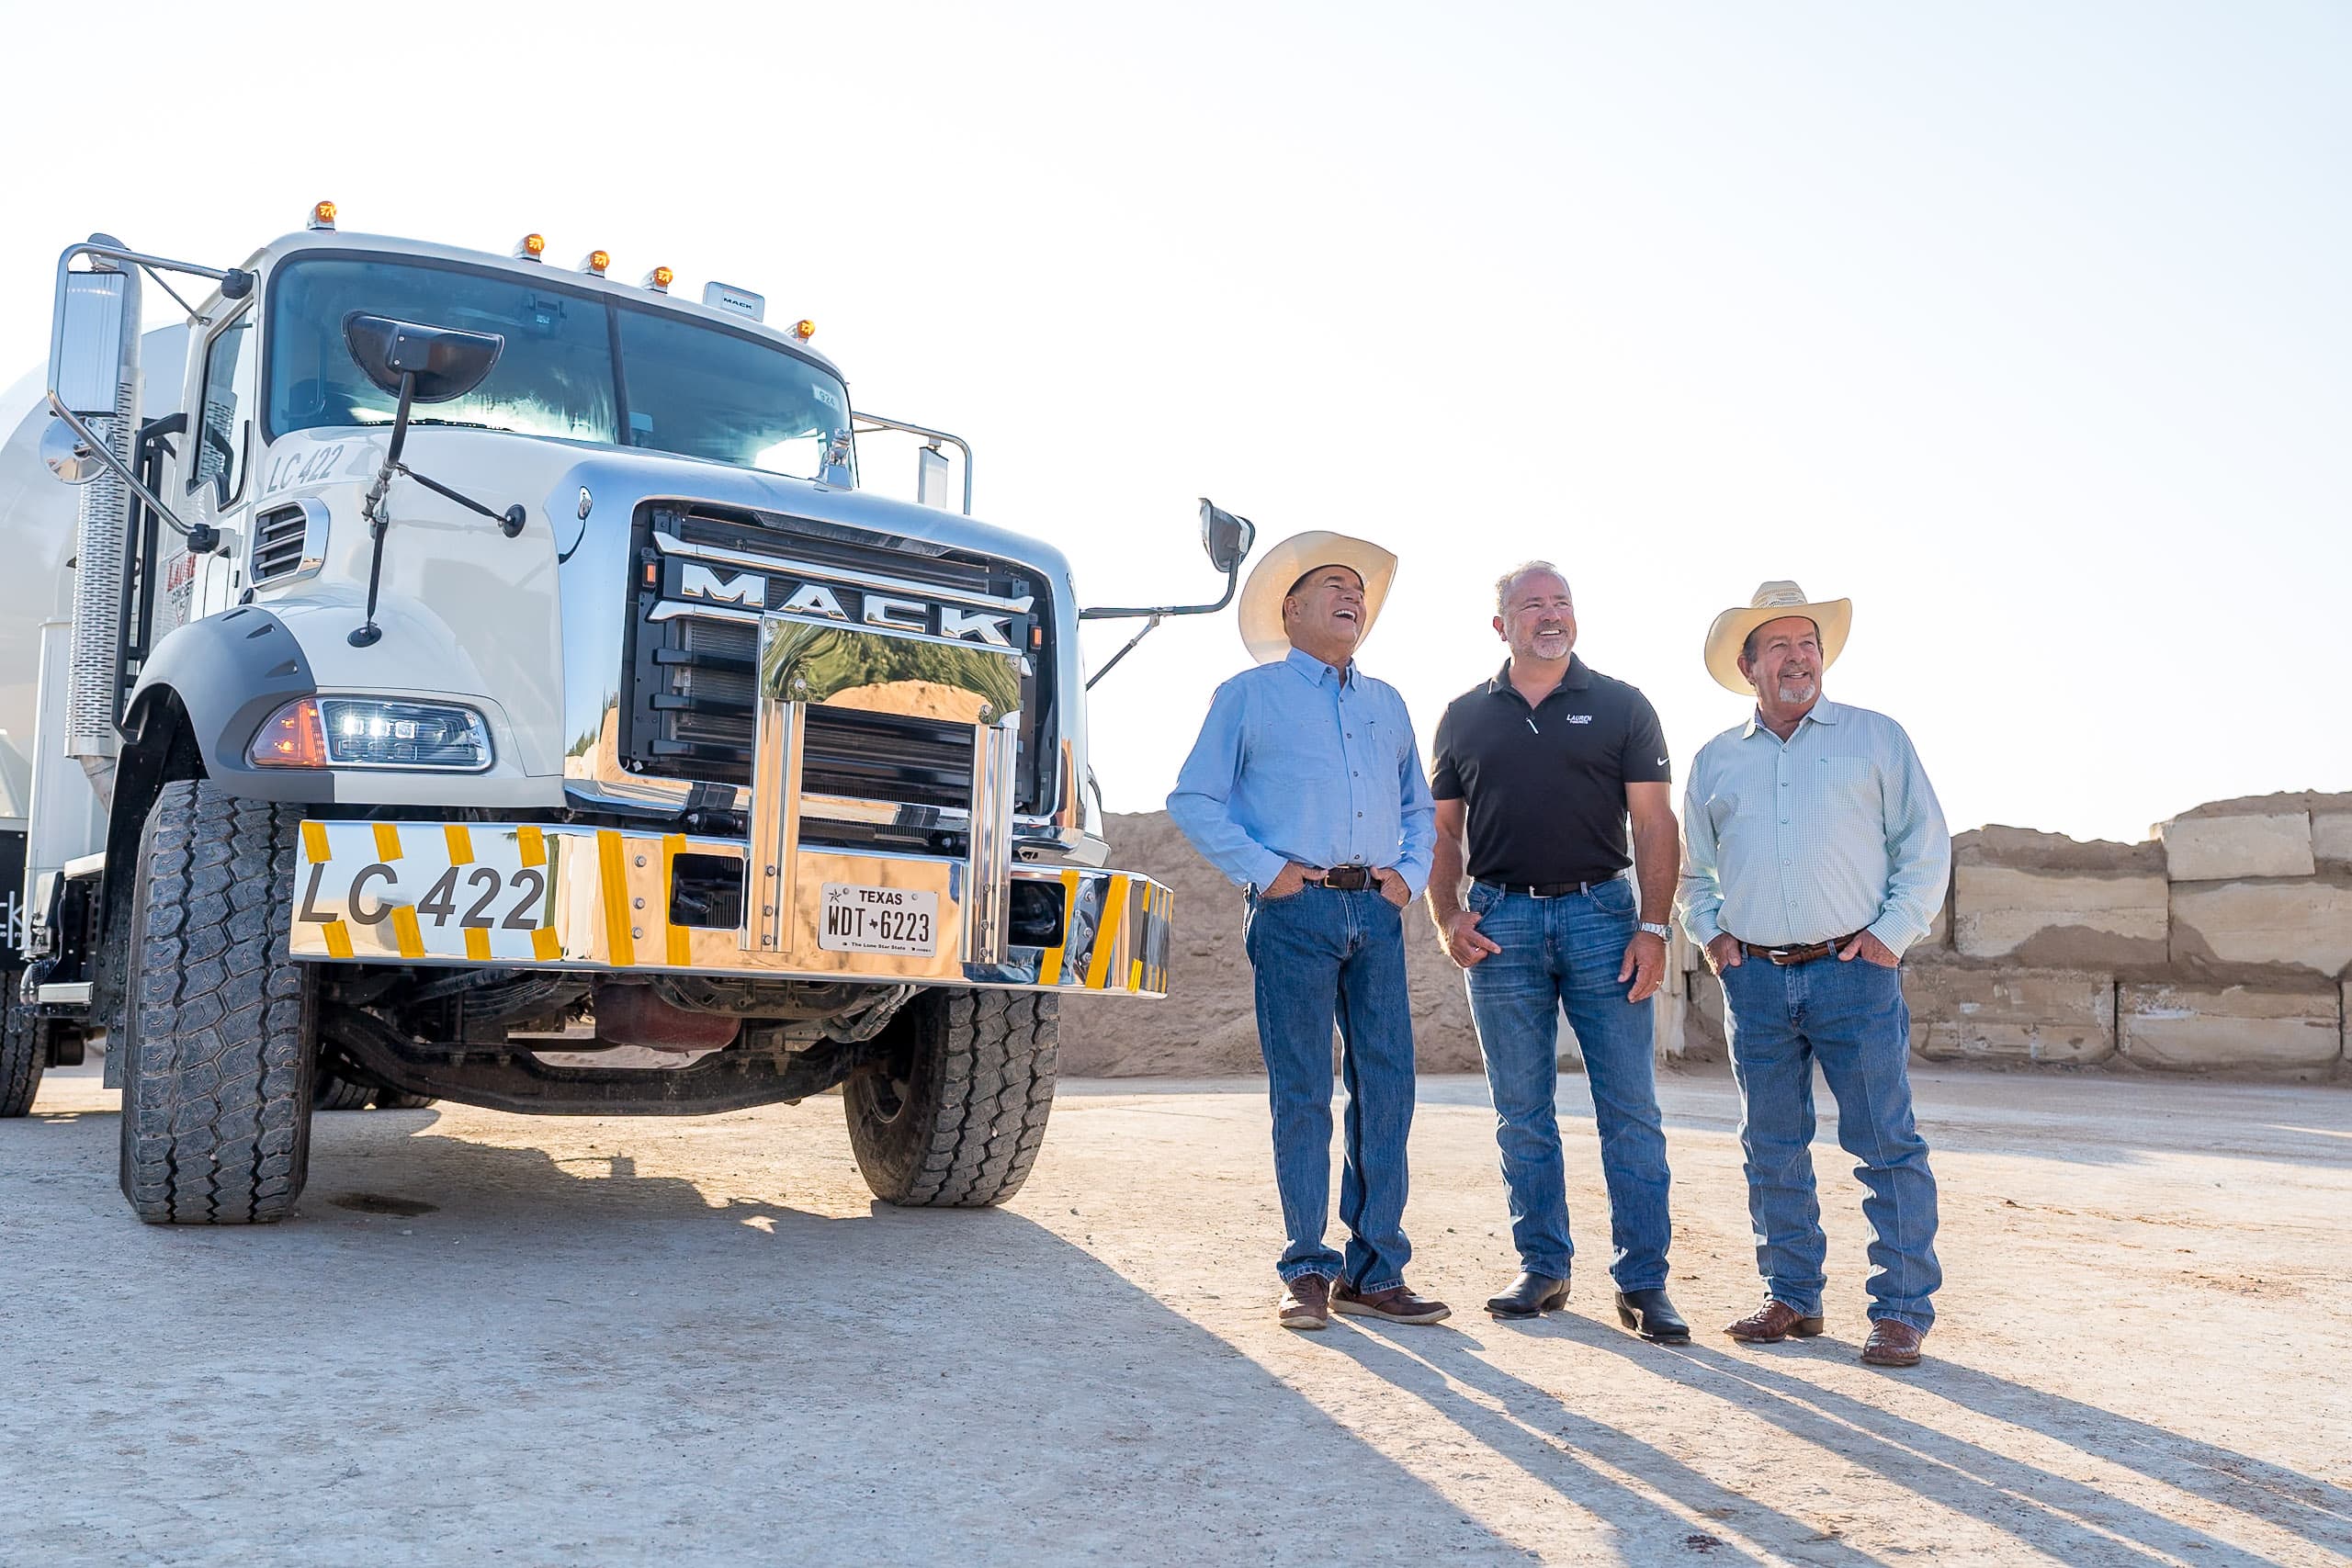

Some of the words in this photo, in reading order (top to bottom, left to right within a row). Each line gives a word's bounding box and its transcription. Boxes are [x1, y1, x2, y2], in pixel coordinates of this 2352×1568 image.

[723, 298, 752, 310] MACK
[267, 453, 301, 492] LC
[299, 445, 345, 484] 422
[682, 562, 1012, 647] MACK
[299, 863, 399, 926] LC
[417, 866, 546, 931] 422
[859, 889, 903, 906] TEXAS
[828, 905, 865, 937] WDT
[880, 909, 930, 942] 6223
